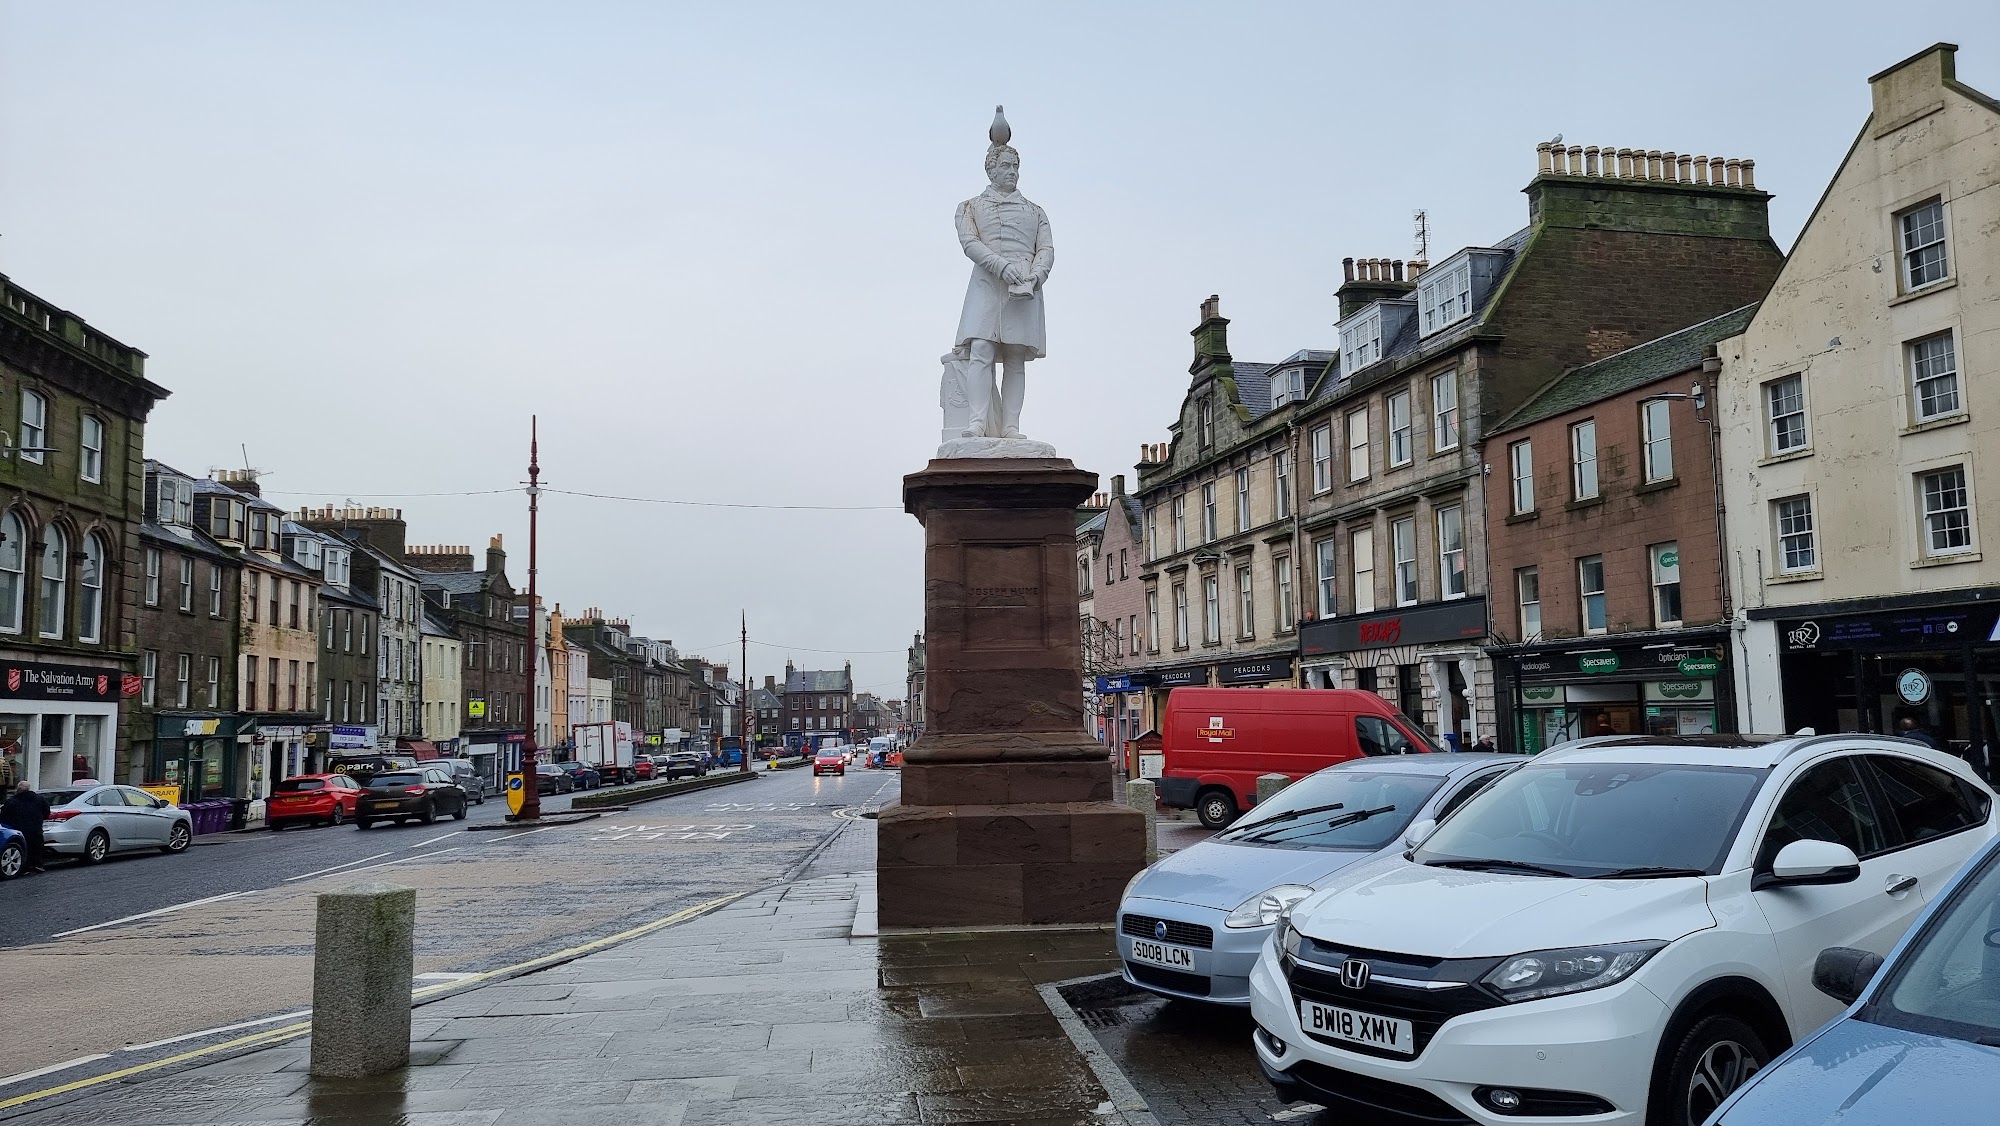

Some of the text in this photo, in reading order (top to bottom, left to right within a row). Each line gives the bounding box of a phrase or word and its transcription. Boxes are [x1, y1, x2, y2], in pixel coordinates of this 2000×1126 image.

[968, 587, 1039, 596] JOSEPH HUME
[1658, 652, 1686, 663] Opticians
[1521, 662, 1550, 671] Audiologists
[1583, 658, 1615, 668] Specsavers
[1683, 662, 1716, 671] Specsavers
[1233, 664, 1271, 674] PEACOCKS
[24, 669, 95, 689] The Salvation Army
[1161, 672, 1191, 680] PEACOCKS
[1662, 681, 1698, 692] Specsavers
[183, 718, 220, 736] SUBWAY
[589, 832, 732, 840] KEEP
[1136, 942, 1190, 966] SD08 LCN
[1312, 1005, 1398, 1045] BW18 XMV
